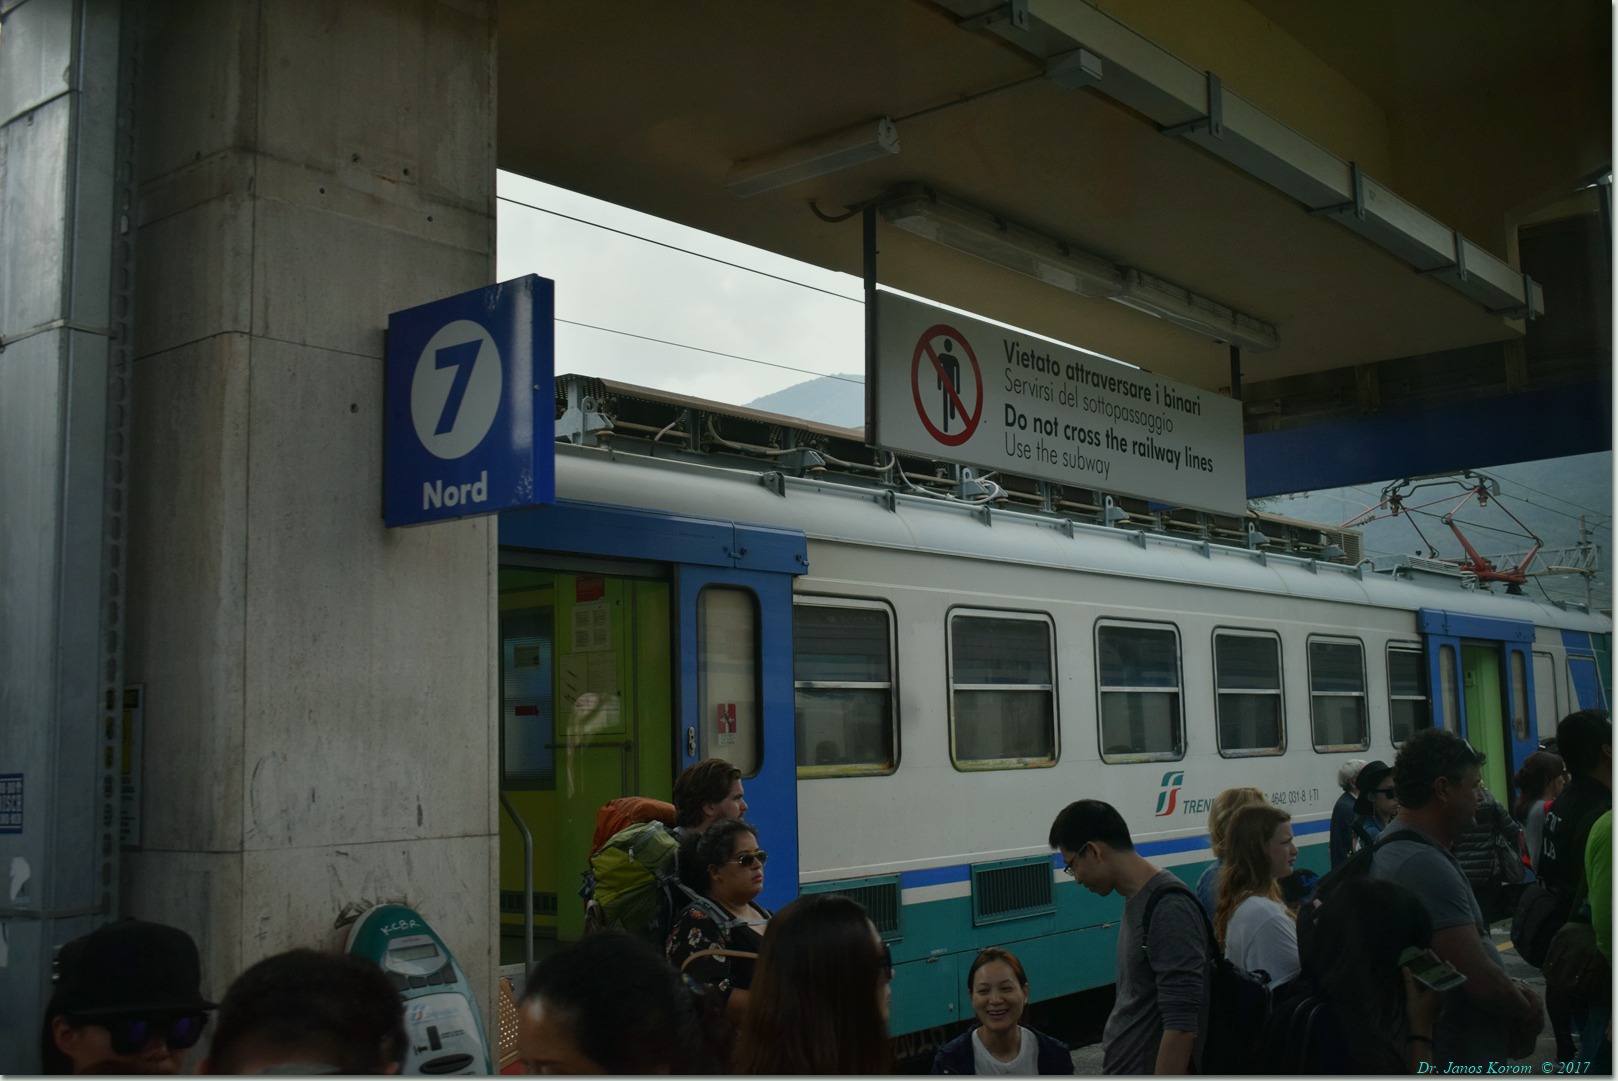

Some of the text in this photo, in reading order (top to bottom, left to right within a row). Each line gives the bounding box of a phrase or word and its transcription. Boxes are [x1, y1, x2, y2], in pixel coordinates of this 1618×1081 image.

[434, 338, 484, 436] 7
[1003, 339, 1201, 416] Vietato attraversare i binari
[1004, 367, 1174, 436] Servirsi del sottopassaggio
[1004, 403, 1214, 473] Do not cross the railway lines
[1005, 431, 1111, 481] Use the subway
[422, 470, 488, 511] Nord
[1271, 791, 1287, 805] 4642
